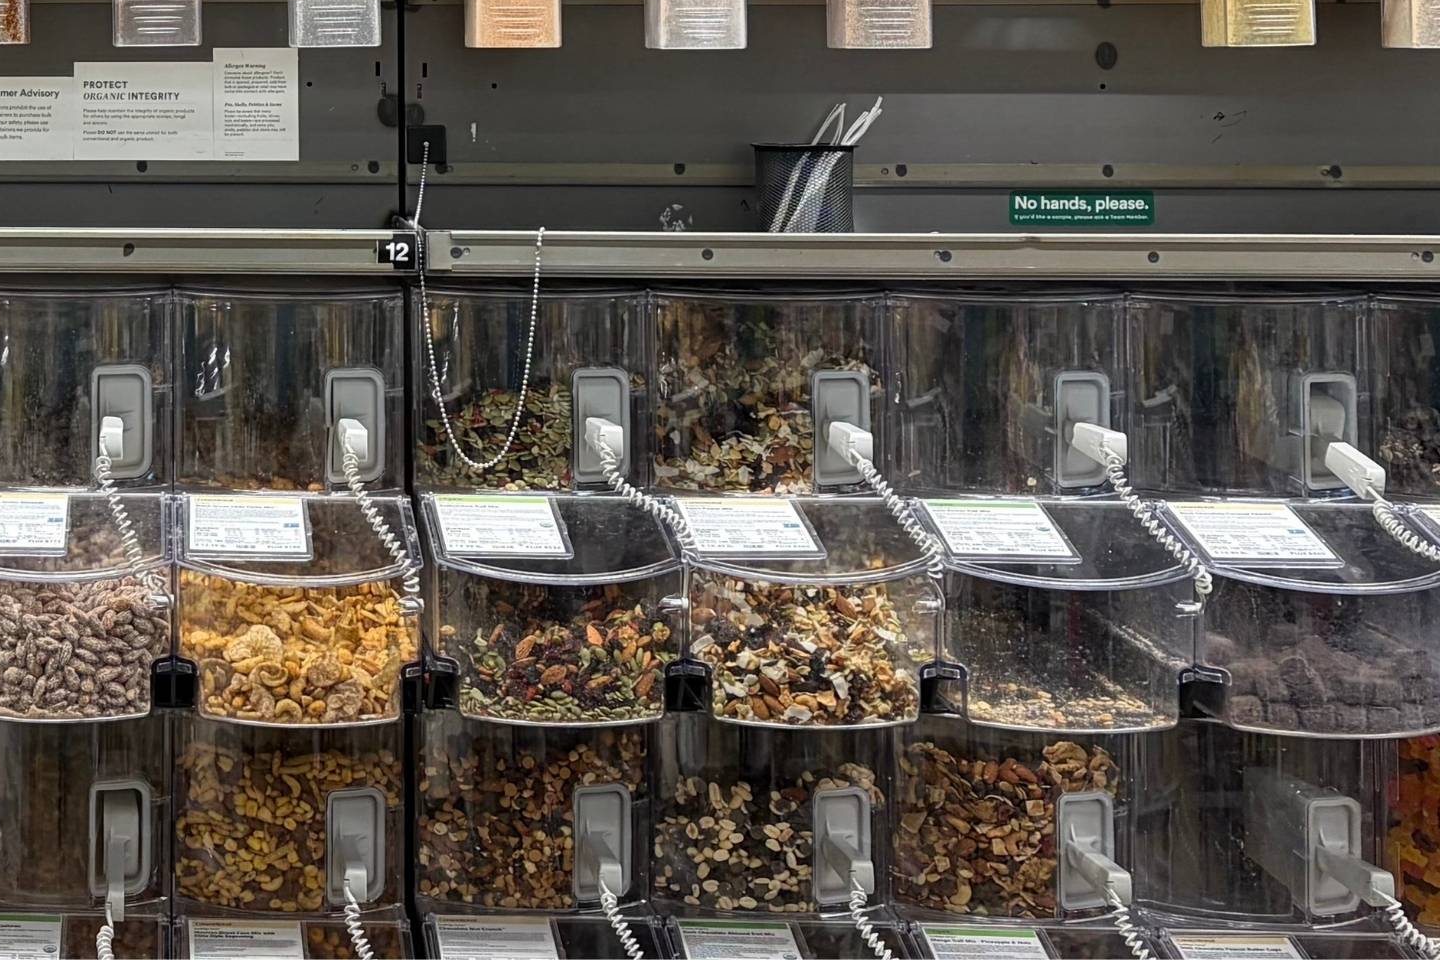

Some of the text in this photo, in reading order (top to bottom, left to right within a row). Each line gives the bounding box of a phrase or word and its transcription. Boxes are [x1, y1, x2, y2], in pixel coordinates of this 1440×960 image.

[83, 80, 129, 89] PROTECT
[19, 88, 60, 100] Advisory
[83, 92, 180, 101] ORGANIC INTEGRITY
[1014, 195, 1150, 214] No hands, please.
[385, 242, 409, 261] 12
